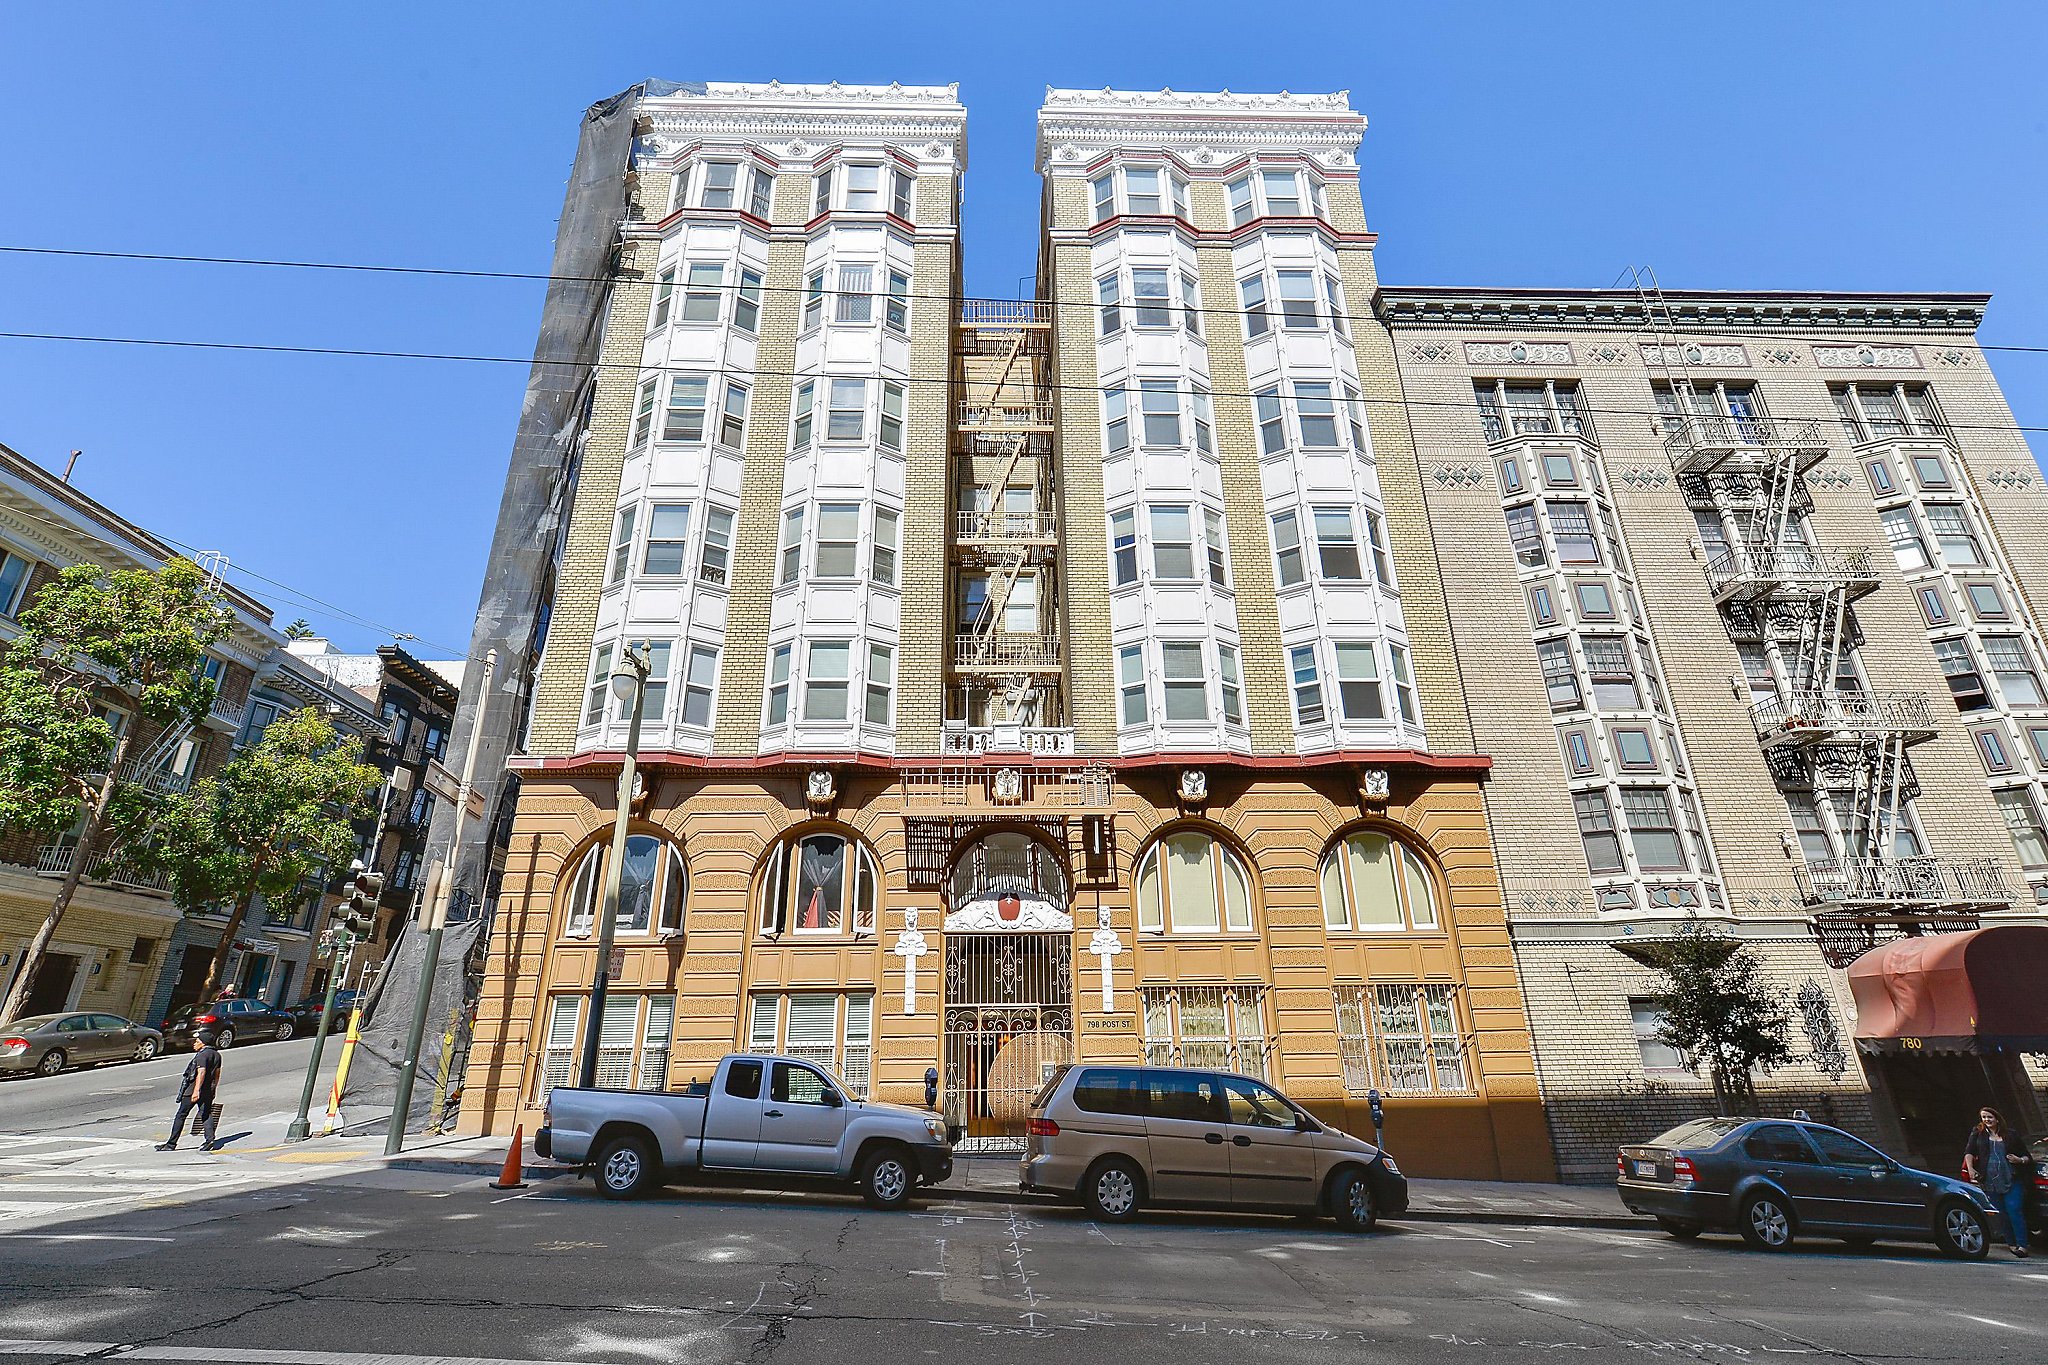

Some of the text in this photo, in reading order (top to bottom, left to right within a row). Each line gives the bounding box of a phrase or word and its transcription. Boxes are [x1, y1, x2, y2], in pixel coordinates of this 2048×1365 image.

[1087, 1020, 1132, 1028] 798 POST ST.
[1900, 1037, 1922, 1049] 780
